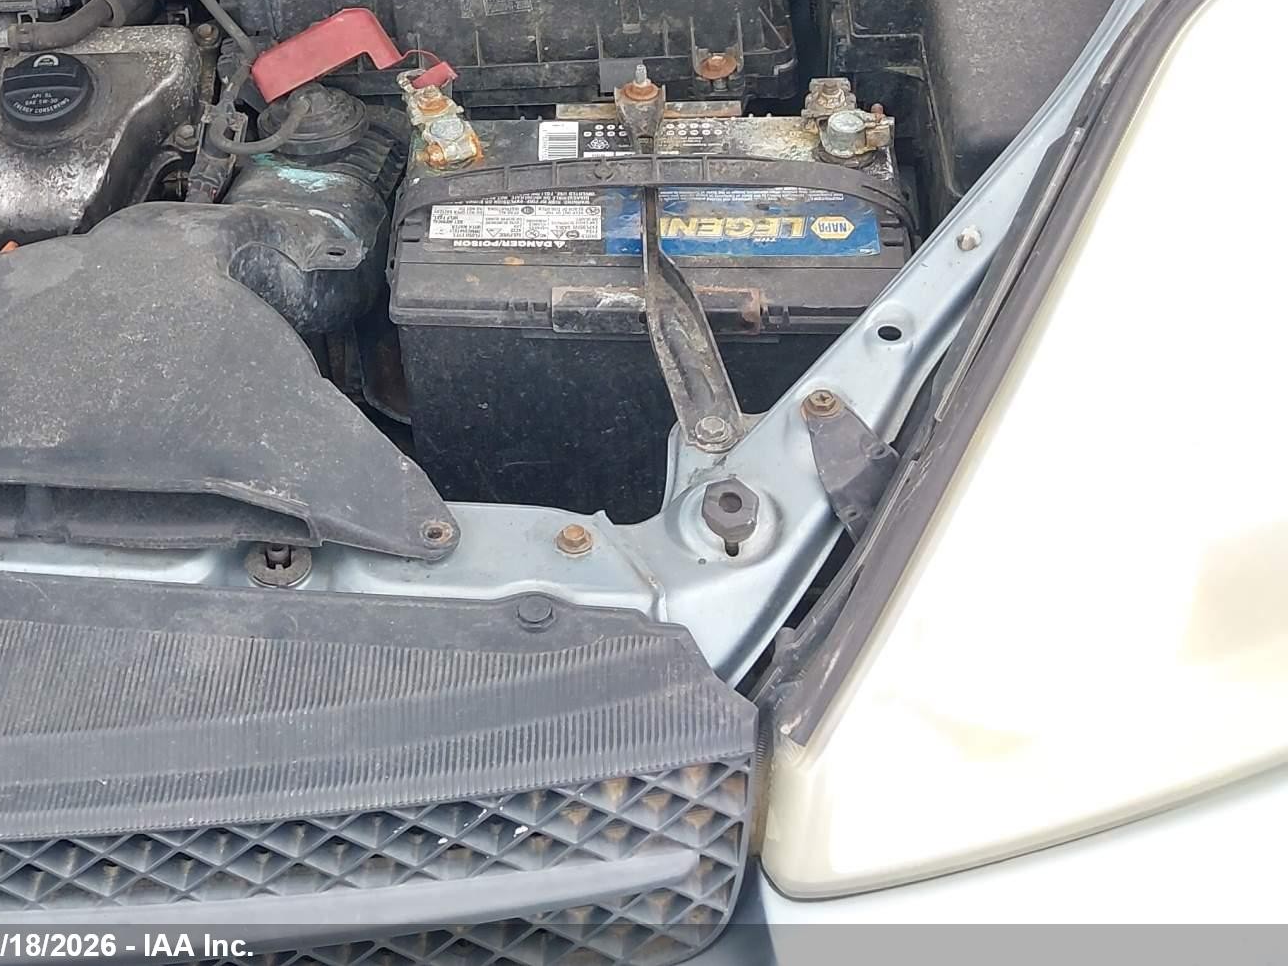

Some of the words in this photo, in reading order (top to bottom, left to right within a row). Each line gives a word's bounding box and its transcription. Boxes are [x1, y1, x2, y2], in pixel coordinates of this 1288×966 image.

[659, 216, 808, 239] LEGEN
[818, 222, 847, 233] NAPA
[453, 240, 553, 248] DANGER/POISON
